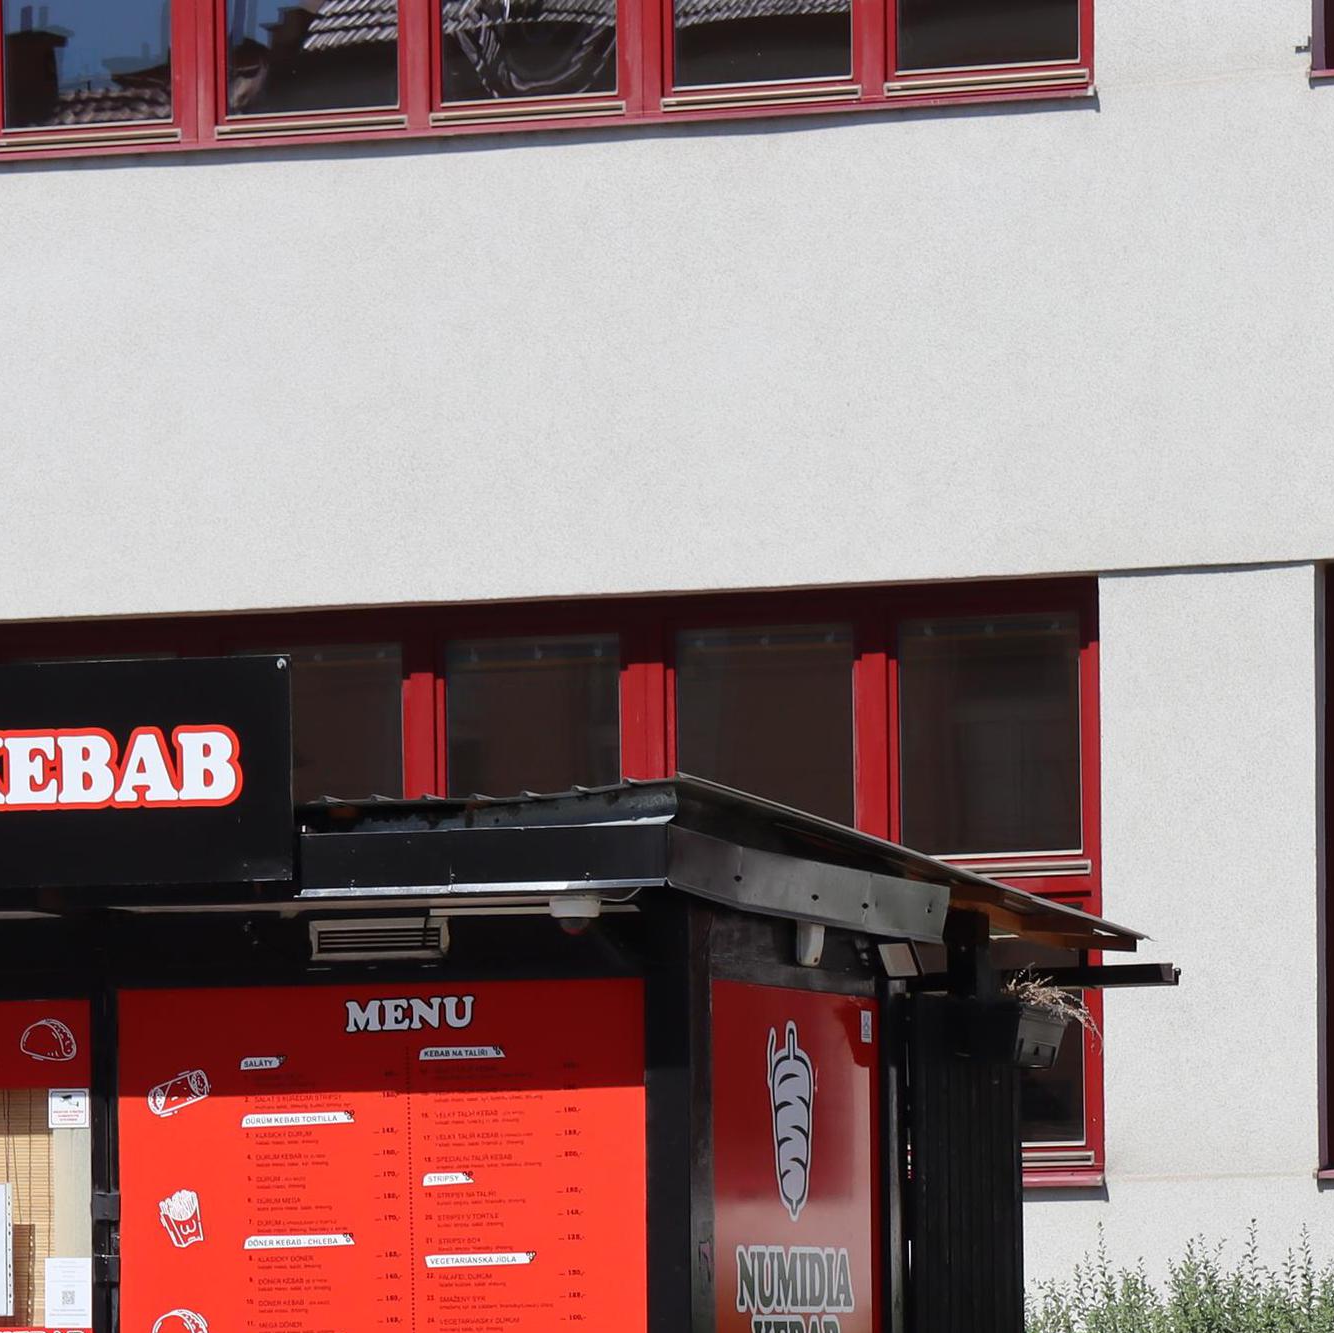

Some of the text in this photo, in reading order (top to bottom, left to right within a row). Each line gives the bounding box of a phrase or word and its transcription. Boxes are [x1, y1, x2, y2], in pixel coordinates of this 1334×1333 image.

[344, 994, 475, 1033] MENU
[424, 1050, 450, 1058] KEBAB
[274, 1116, 300, 1124] KEBAB
[302, 1114, 338, 1123] TORTILLA
[247, 1239, 274, 1247] DÖNER
[275, 1238, 302, 1246] KEBAB
[736, 1245, 855, 1314] NUMIDIA
